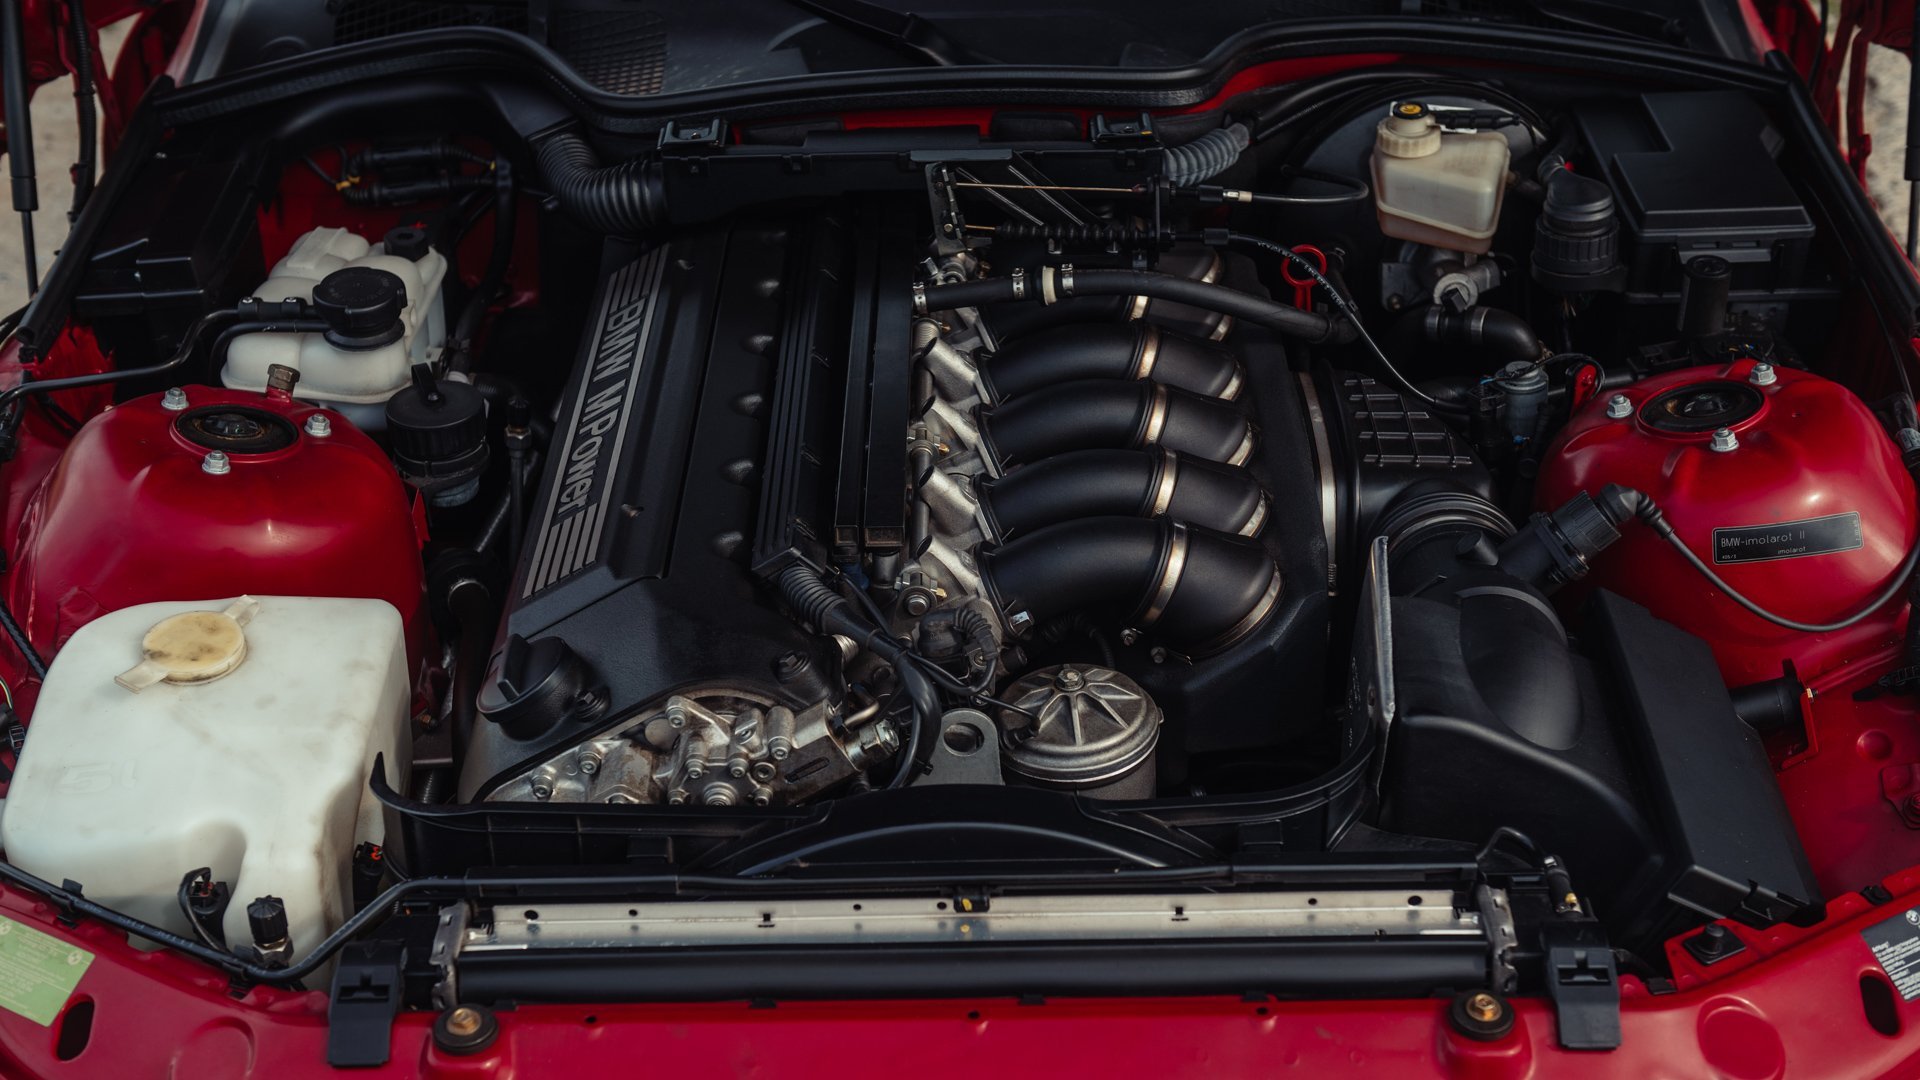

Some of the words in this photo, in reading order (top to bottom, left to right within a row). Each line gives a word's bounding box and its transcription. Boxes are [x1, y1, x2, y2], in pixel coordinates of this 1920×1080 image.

[593, 298, 646, 383] BMW
[557, 378, 626, 519] MPower
[1720, 531, 1793, 548] BMW-imolarot
[1777, 546, 1806, 555] imolarot
